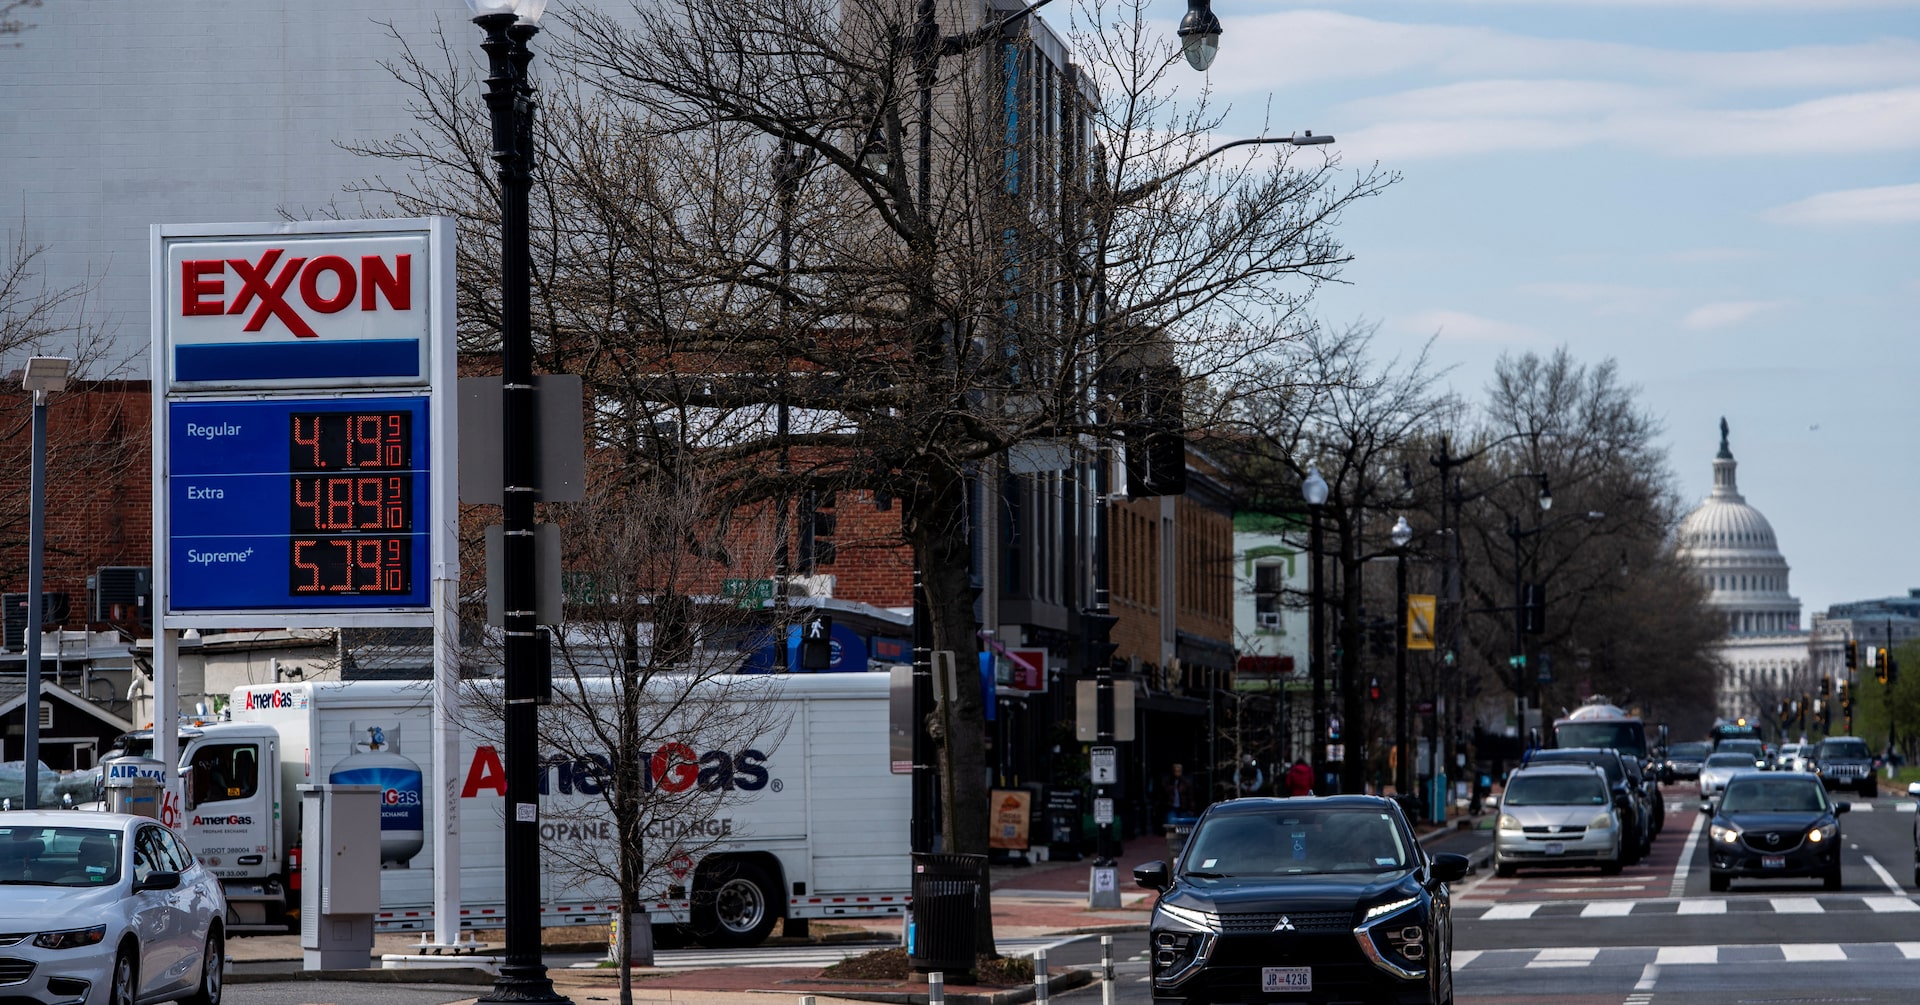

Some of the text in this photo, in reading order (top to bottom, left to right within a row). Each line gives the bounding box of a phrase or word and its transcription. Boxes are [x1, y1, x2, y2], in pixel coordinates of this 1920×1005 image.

[182, 249, 412, 338] EXXON
[187, 422, 241, 440] Regular
[295, 416, 381, 467] 4.19
[187, 486, 224, 499] Extra
[296, 478, 382, 529] 4.89
[246, 689, 292, 710] AmeriGas
[110, 765, 138, 778] AIR
[381, 788, 418, 806] iGas
[192, 815, 252, 826] AmeriGas
[540, 822, 611, 841] OPANE
[1266, 973, 1308, 986] JR 4236
